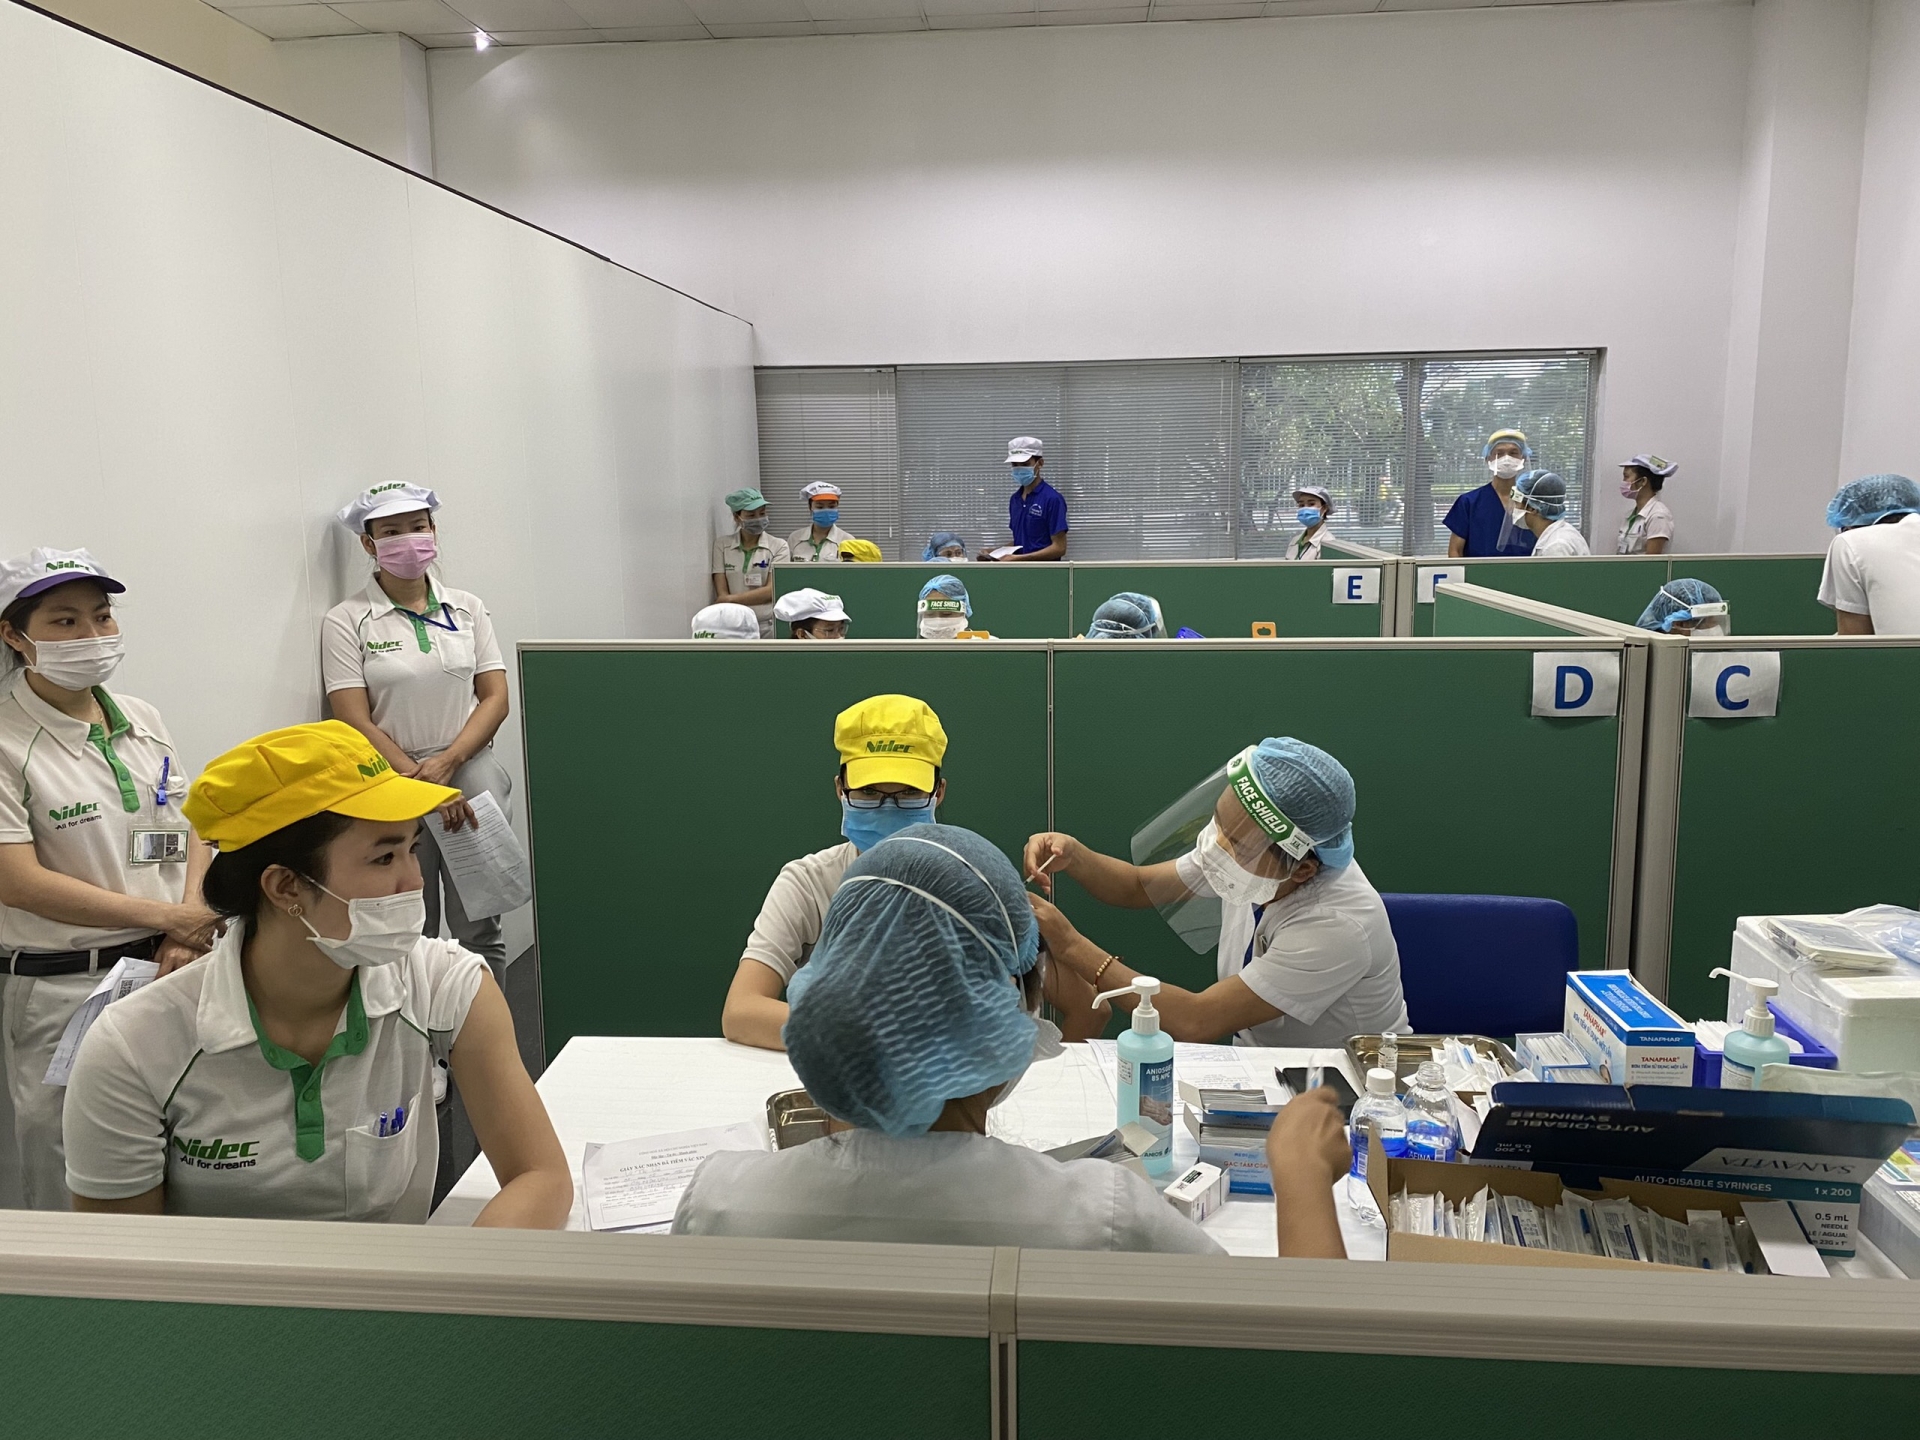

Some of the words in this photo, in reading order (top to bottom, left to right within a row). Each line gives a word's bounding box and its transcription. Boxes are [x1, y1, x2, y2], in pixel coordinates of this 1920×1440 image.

[1347, 575, 1363, 599] E
[366, 641, 403, 650] Nidec
[1555, 666, 1593, 709] D
[1715, 665, 1751, 710] C
[865, 740, 915, 754] Nidec
[357, 753, 390, 781] Nid
[49, 802, 101, 821] Nidec
[1236, 776, 1259, 802] FACE
[1252, 800, 1288, 834] SHIELD
[79, 815, 102, 824] dreams
[1583, 1008, 1605, 1037] TANAPHAR
[1506, 1119, 1655, 1133] AUTO-DISABLE
[1510, 1111, 1611, 1122] SYRINGES
[174, 1136, 259, 1160] Nidec
[180, 1155, 194, 1165] All
[197, 1160, 211, 1169] for
[213, 1159, 256, 1170] dreams
[1721, 1156, 1855, 1174] SANAVITA
[1633, 1175, 1714, 1188] AUTO-DISABLE
[1716, 1180, 1772, 1192] SYRINGES
[1830, 1188, 1852, 1197] 200
[1815, 1213, 1831, 1221] 0.5
